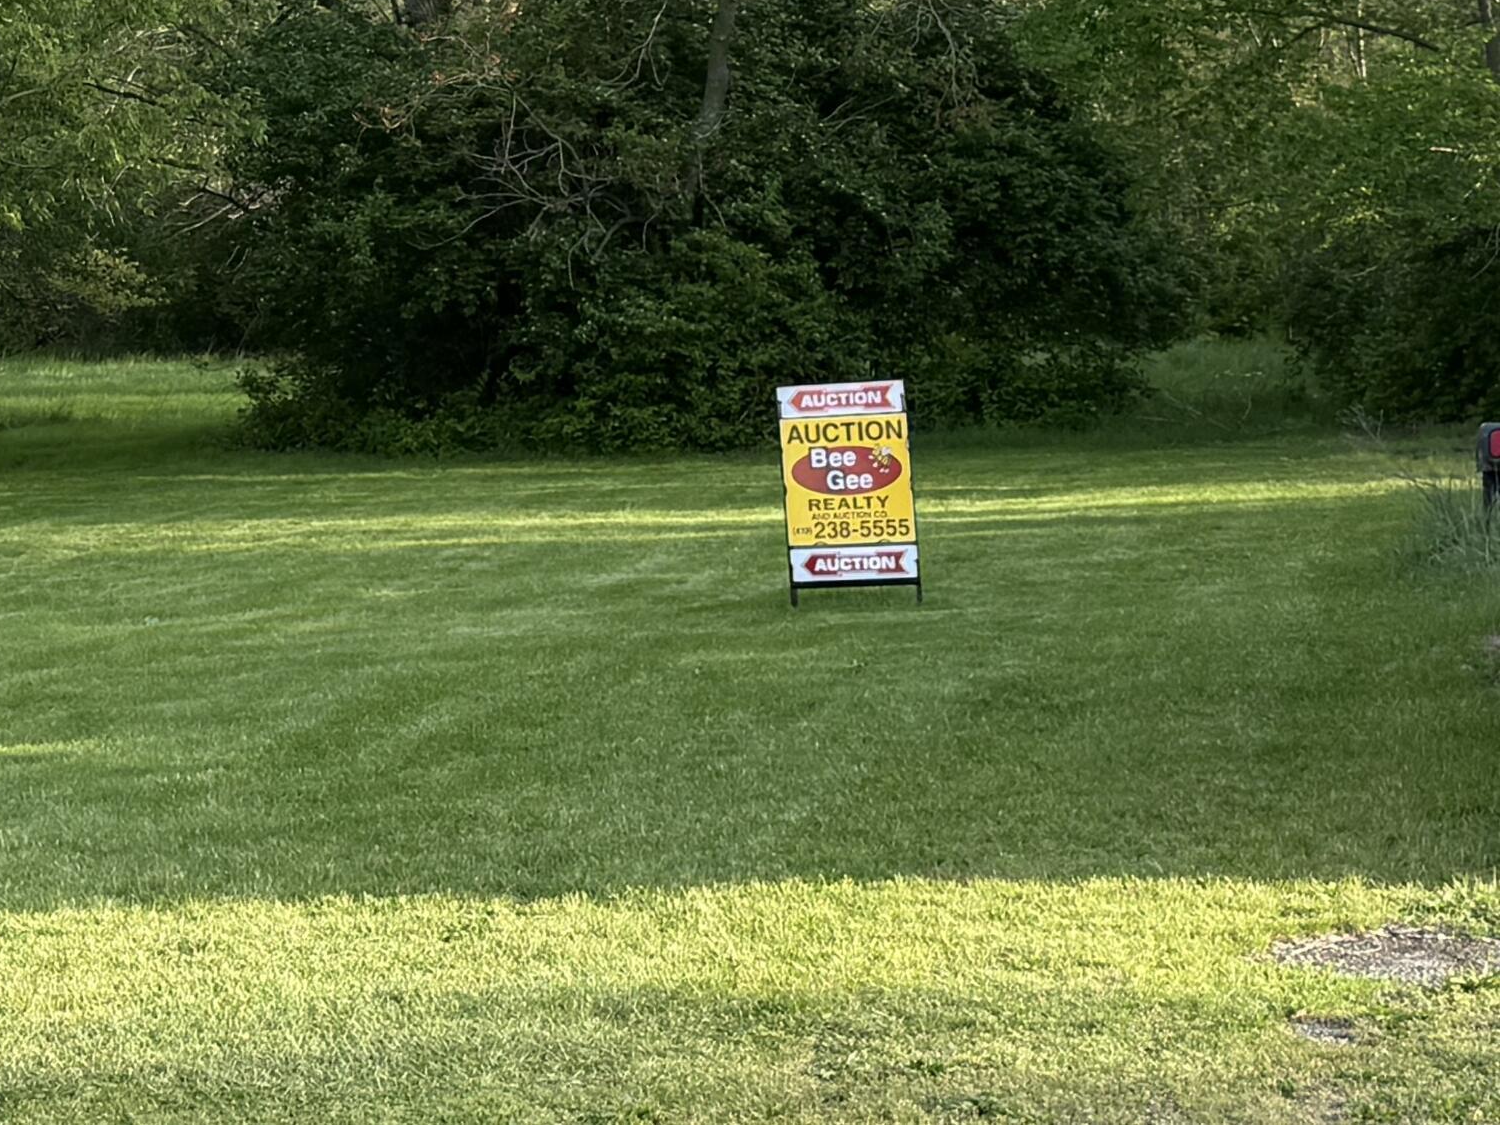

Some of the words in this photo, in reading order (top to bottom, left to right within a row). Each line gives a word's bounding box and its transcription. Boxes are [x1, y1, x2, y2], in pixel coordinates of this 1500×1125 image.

[801, 389, 882, 408] AUCTION
[787, 419, 903, 444] AUCTION
[810, 447, 857, 468] Bee
[826, 470, 874, 490] Gee
[808, 495, 889, 511] REALTY
[811, 512, 831, 520] AND
[833, 511, 872, 520] AUCTION
[814, 519, 910, 539] 238-5555
[814, 555, 896, 572] AUCTION
